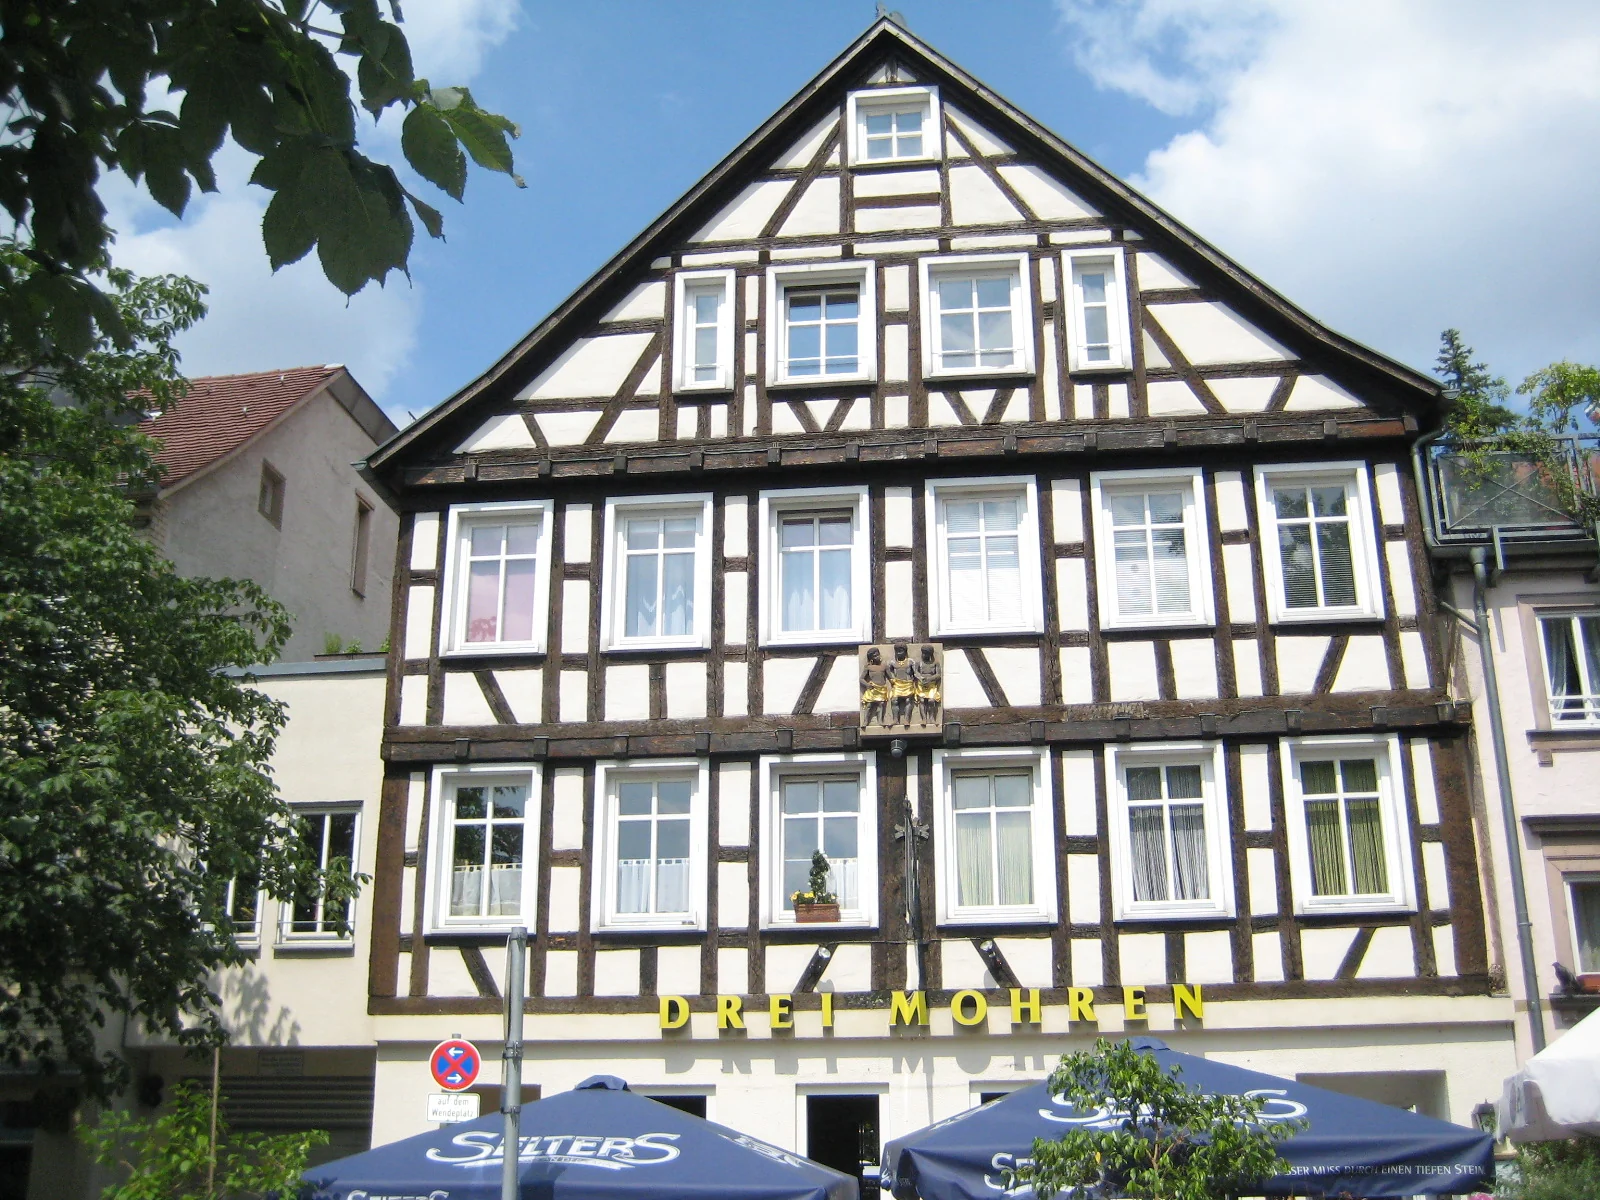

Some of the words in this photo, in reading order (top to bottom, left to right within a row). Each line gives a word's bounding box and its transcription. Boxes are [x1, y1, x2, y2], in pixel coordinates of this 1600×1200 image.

[659, 992, 834, 1029] DREI
[889, 983, 1204, 1026] MOHREN
[453, 1098, 469, 1106] dem
[431, 1108, 474, 1118] Wendeplatz
[1313, 1165, 1341, 1175] MUSS
[1344, 1165, 1379, 1174] DURCH
[1381, 1164, 1412, 1175] EINEN
[1415, 1165, 1451, 1175] TIEFEN
